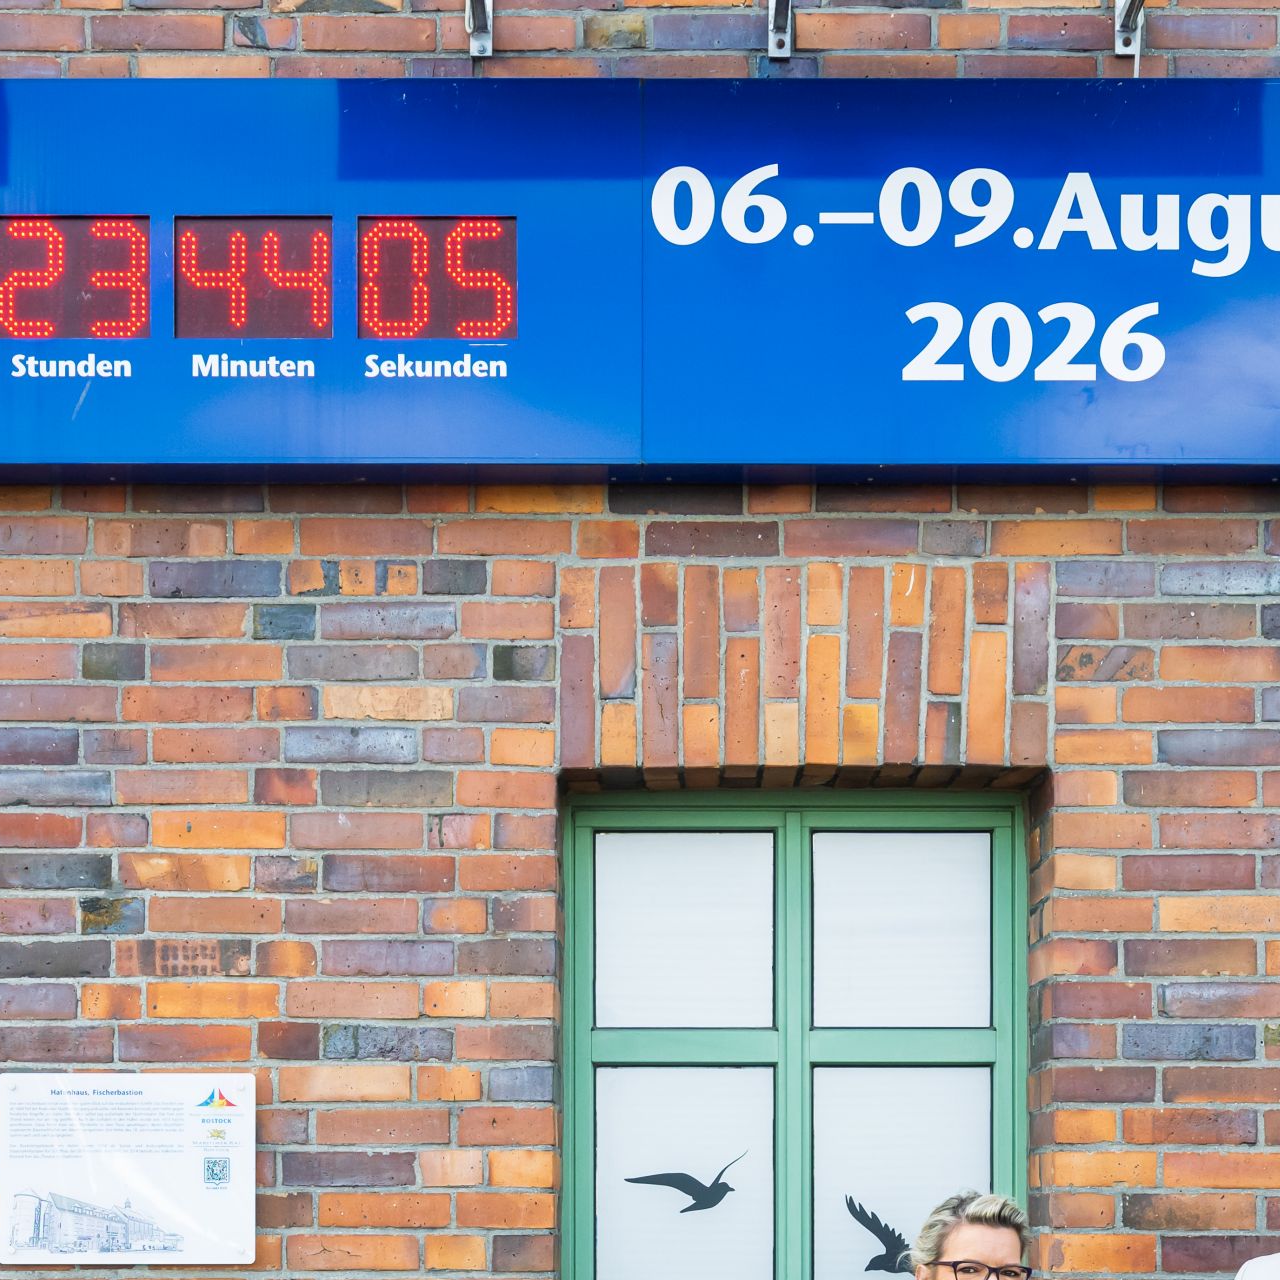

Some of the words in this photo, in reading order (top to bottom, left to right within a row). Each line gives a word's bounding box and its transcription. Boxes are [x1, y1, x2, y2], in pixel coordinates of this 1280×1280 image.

[179, 229, 330, 329] 44
[361, 219, 513, 337] 05
[11, 353, 132, 378] Stunden
[192, 353, 315, 378] Minuten
[364, 353, 507, 378] Sekunden
[902, 301, 1166, 382] 2026
[92, 1088, 143, 1096] Fischerbastion
